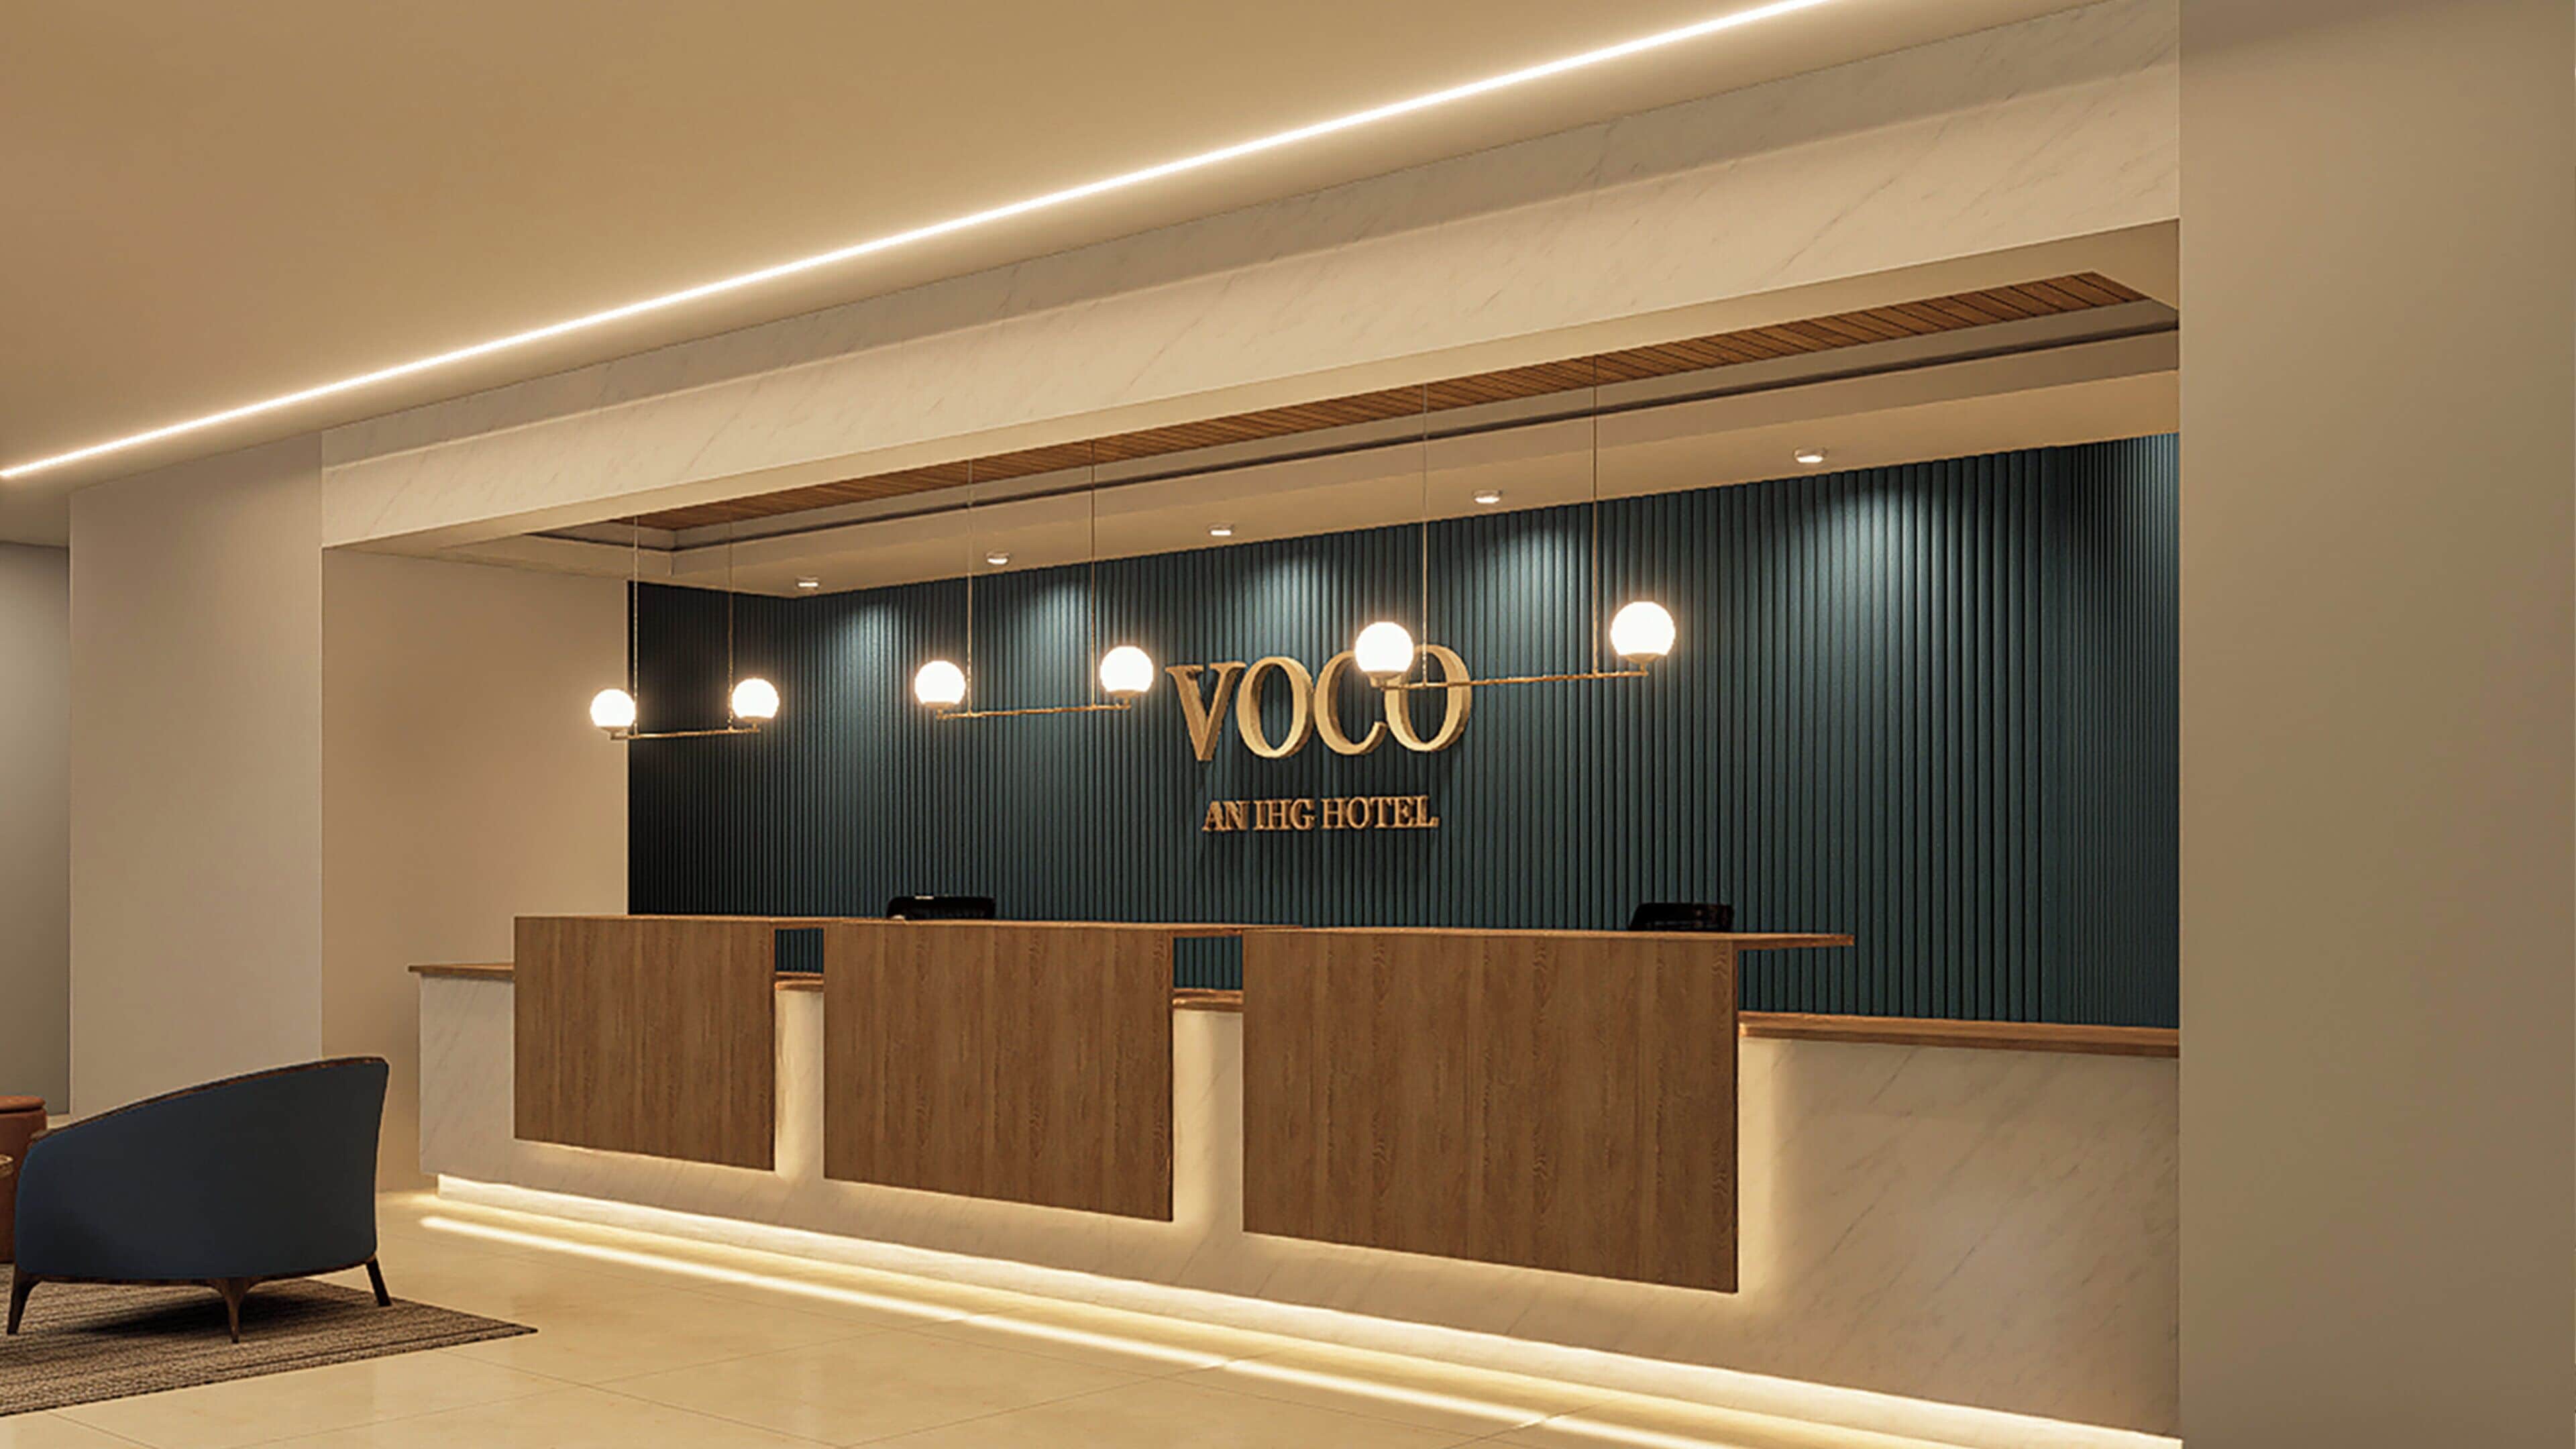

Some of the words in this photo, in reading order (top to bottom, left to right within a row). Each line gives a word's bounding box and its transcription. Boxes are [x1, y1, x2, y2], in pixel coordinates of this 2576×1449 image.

[1165, 644, 1472, 761] VOCO
[1202, 800, 1250, 831] AN
[1253, 798, 1316, 830] IHG
[1320, 794, 1440, 829] HOTEL
